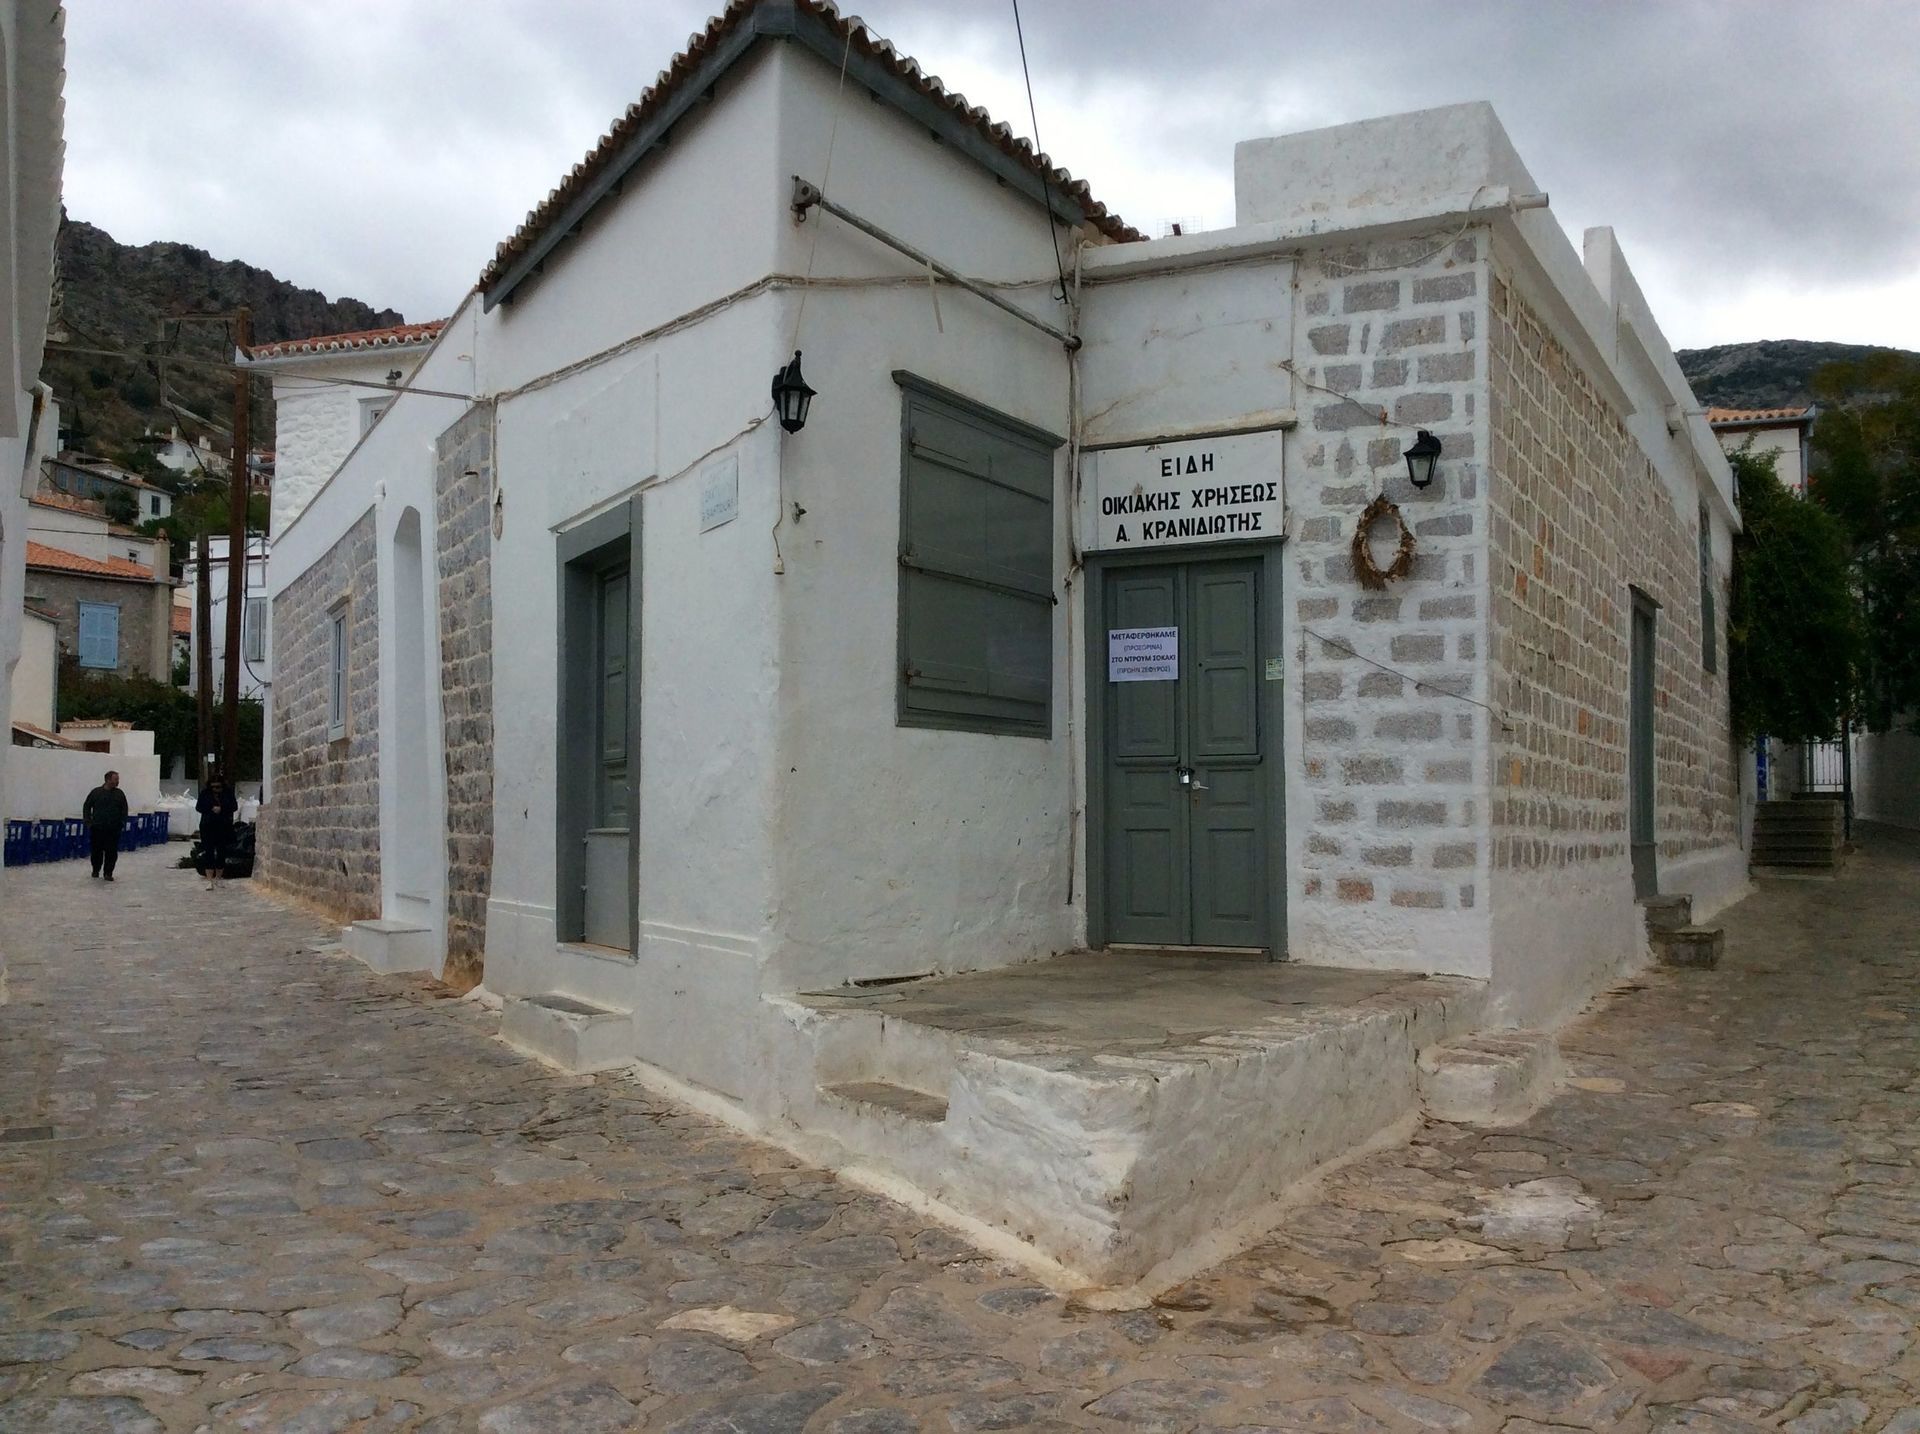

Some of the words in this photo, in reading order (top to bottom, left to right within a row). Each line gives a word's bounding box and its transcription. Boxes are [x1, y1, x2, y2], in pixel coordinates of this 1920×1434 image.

[1161, 453, 1214, 477] ΕΙΔΗ
[1102, 491, 1181, 516] ΟΙΚΙΑΚΗΣ
[1191, 482, 1277, 508] ΧΡΗΣΕΩΣ
[1115, 524, 1131, 543] Α.
[1142, 512, 1262, 541] ΚΡΑΝΙΔΙΩΤΗΣ
[1111, 631, 1176, 640] ΜΕΤΑΦΕΡΘΗΚΑΜΕ
